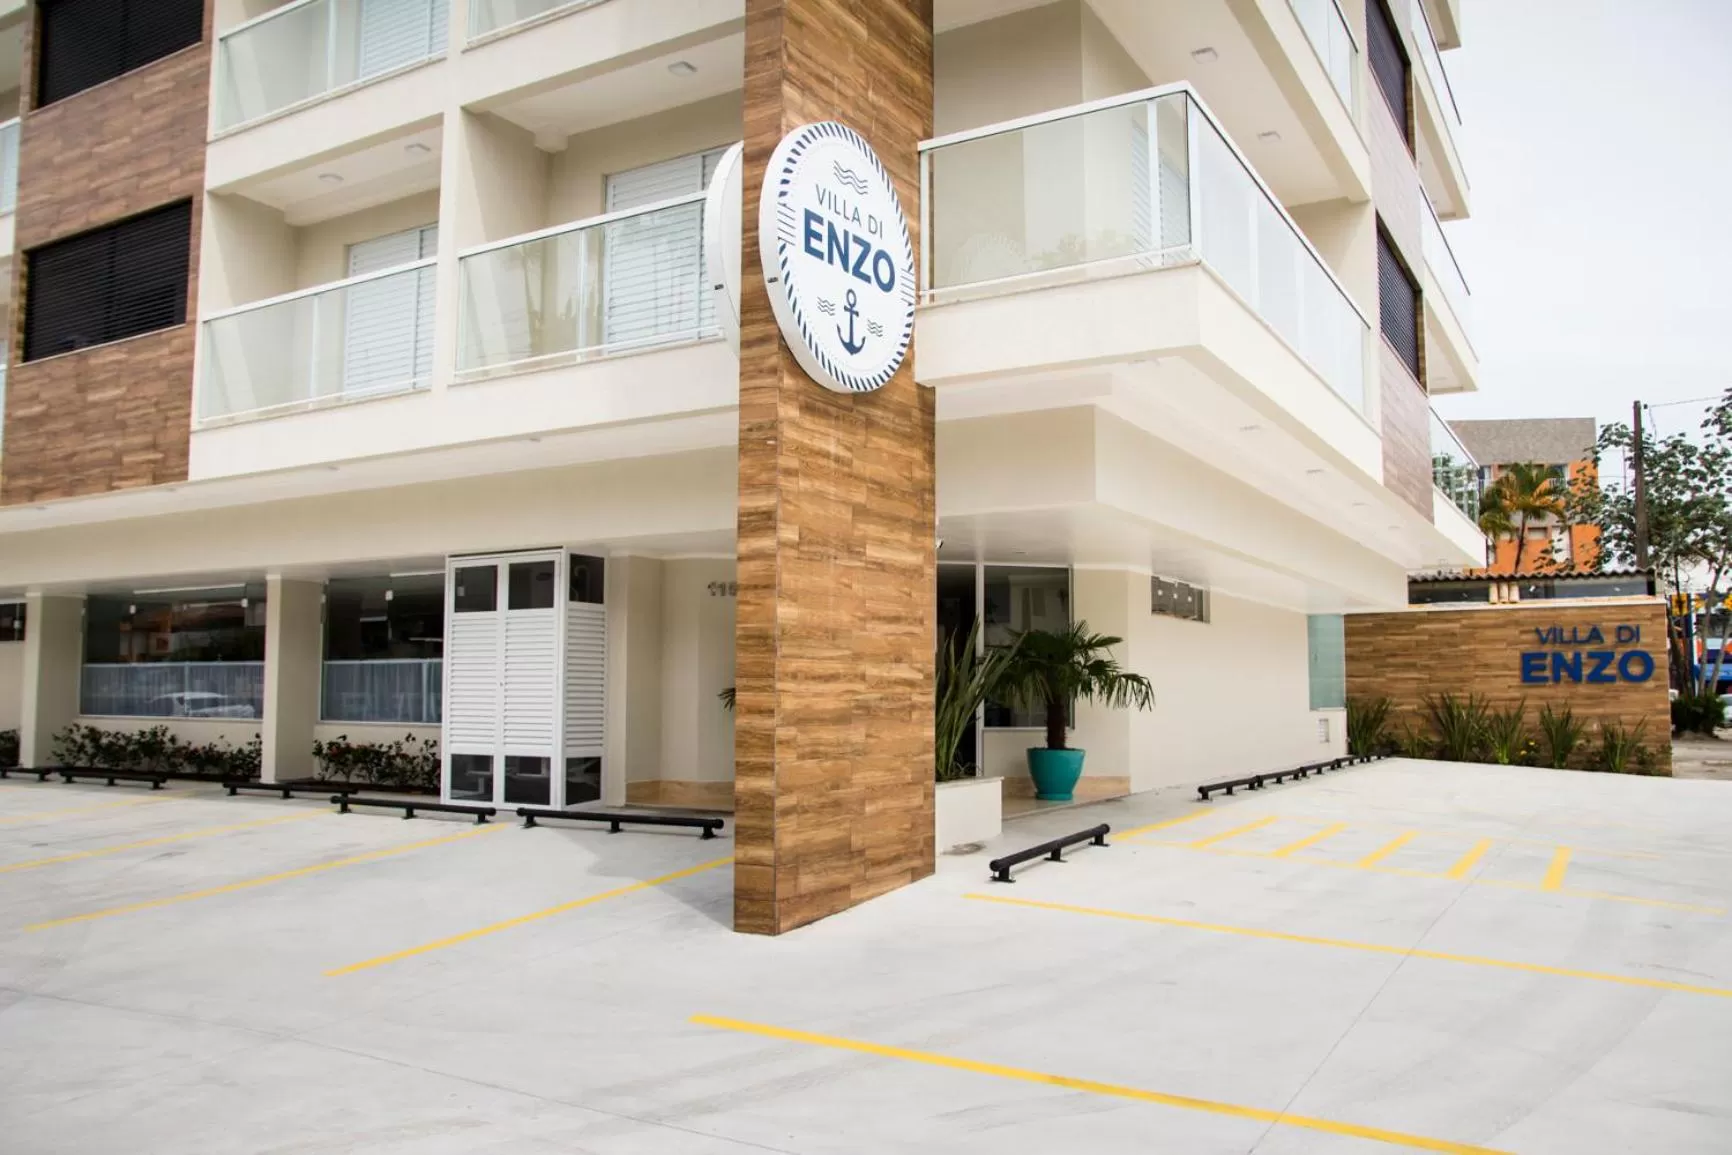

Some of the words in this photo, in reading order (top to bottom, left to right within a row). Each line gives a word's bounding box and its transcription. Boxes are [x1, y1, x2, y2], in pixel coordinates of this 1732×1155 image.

[816, 184, 861, 226] VILLA
[868, 215, 883, 240] DI
[804, 208, 895, 293] ENZO
[1536, 626, 1604, 644] VILLA
[1617, 624, 1640, 643] DI
[1521, 651, 1655, 683] ENZO
